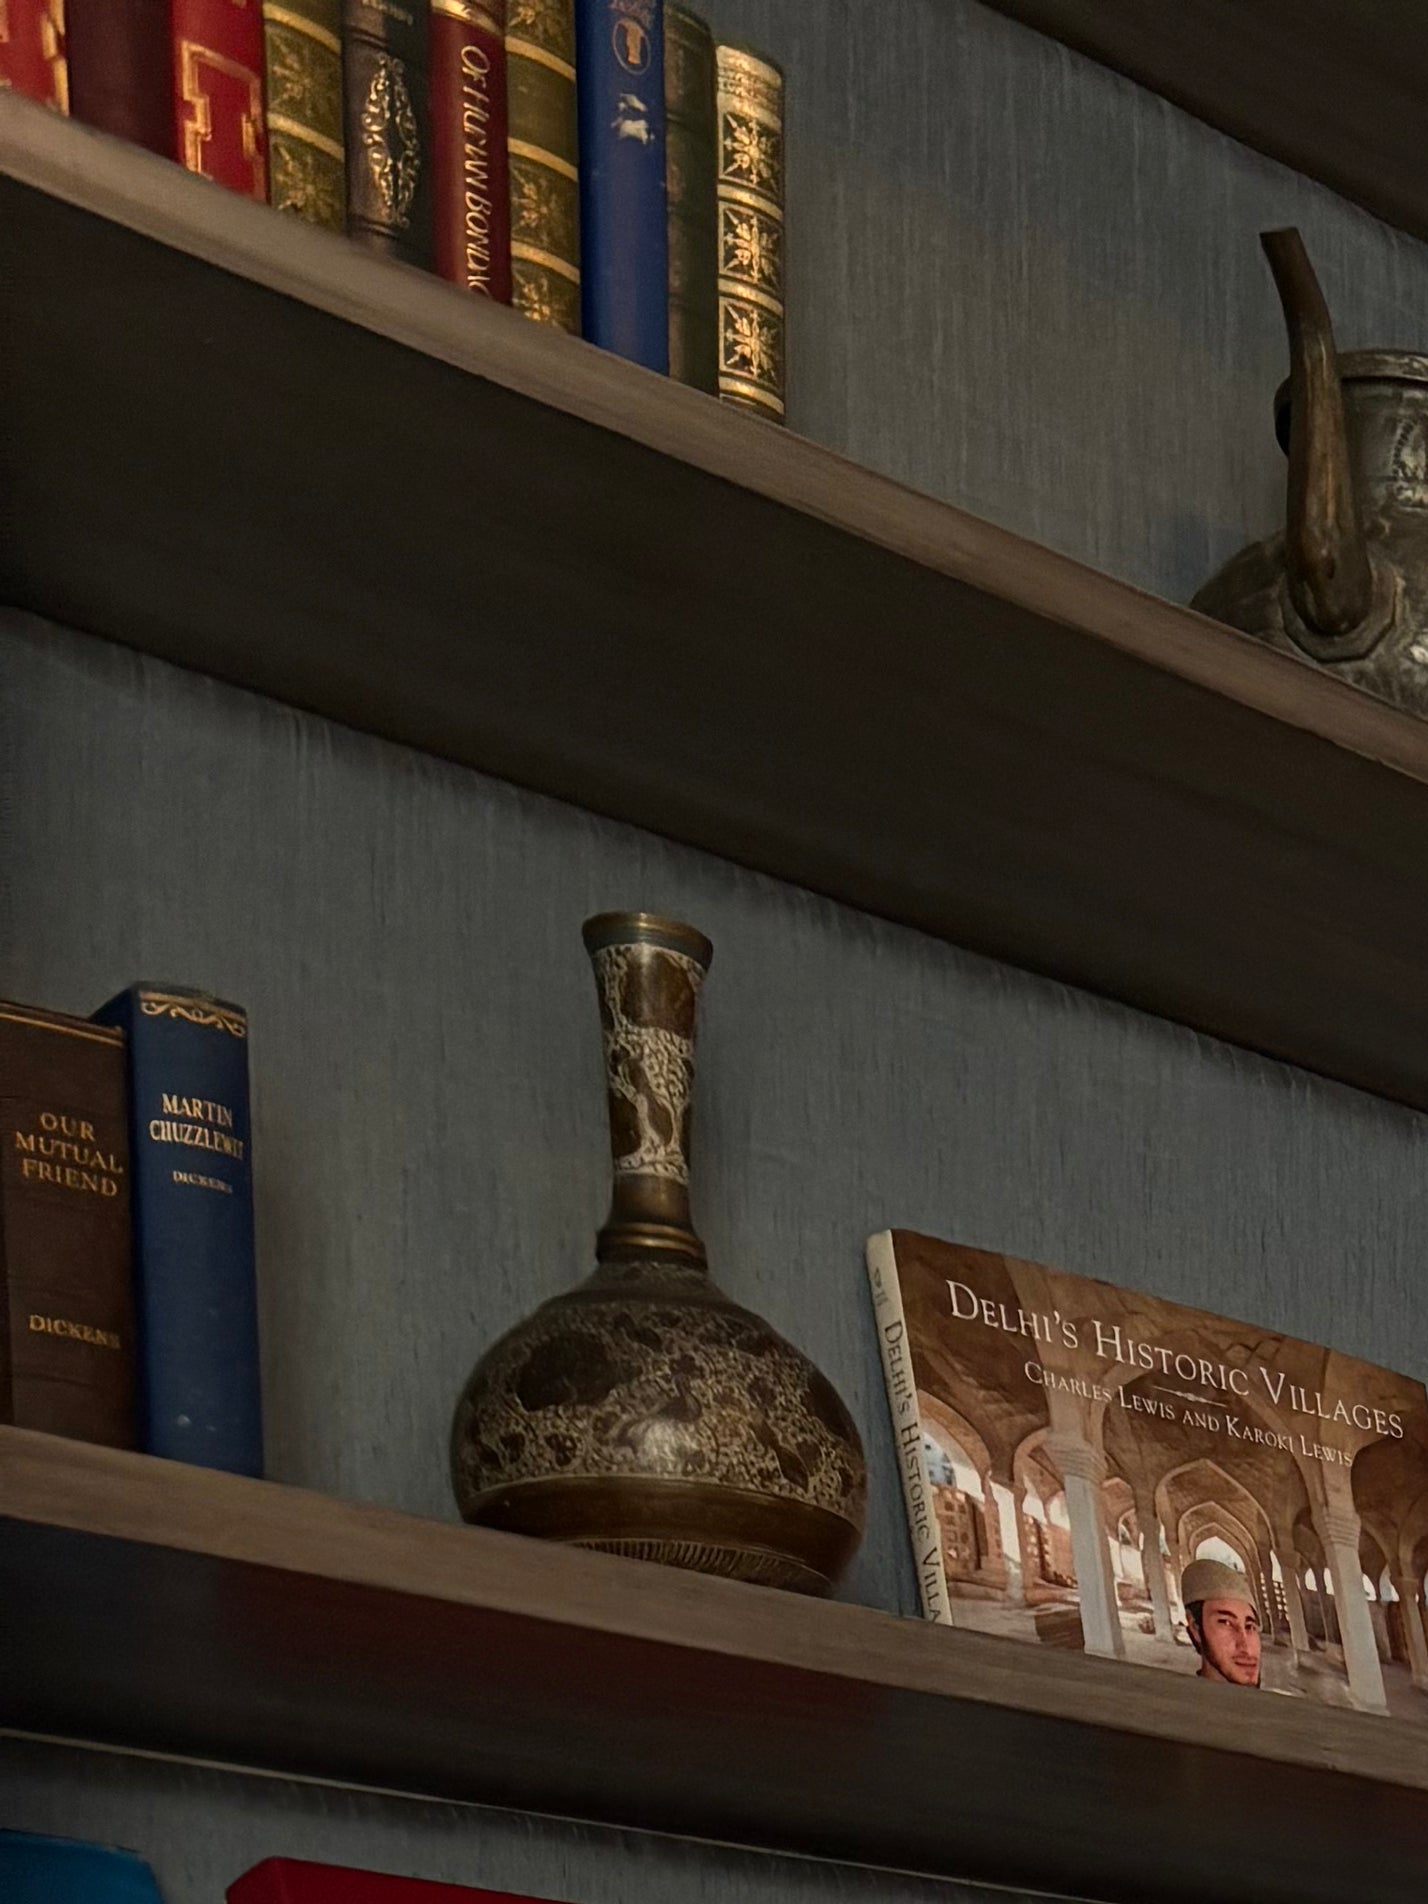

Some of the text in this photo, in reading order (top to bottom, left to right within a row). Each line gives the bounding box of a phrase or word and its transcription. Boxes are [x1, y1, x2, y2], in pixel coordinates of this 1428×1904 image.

[39, 1112, 96, 1141] OUR
[161, 1093, 233, 1127] MARTIN
[15, 1131, 124, 1174] MUTUAL
[150, 1120, 244, 1161] CHUZZLEWIT
[22, 1158, 118, 1197] FRIEND
[172, 1170, 234, 1194] DICKENS
[28, 1314, 121, 1349] DICKENS
[945, 1279, 1404, 1439] DELHI'S HISTORIC VILLAGES
[1024, 1361, 1353, 1468] CHARLES LEWIS AND KAROKI LEWIS
[901, 1422, 930, 1544] HISTORIC
